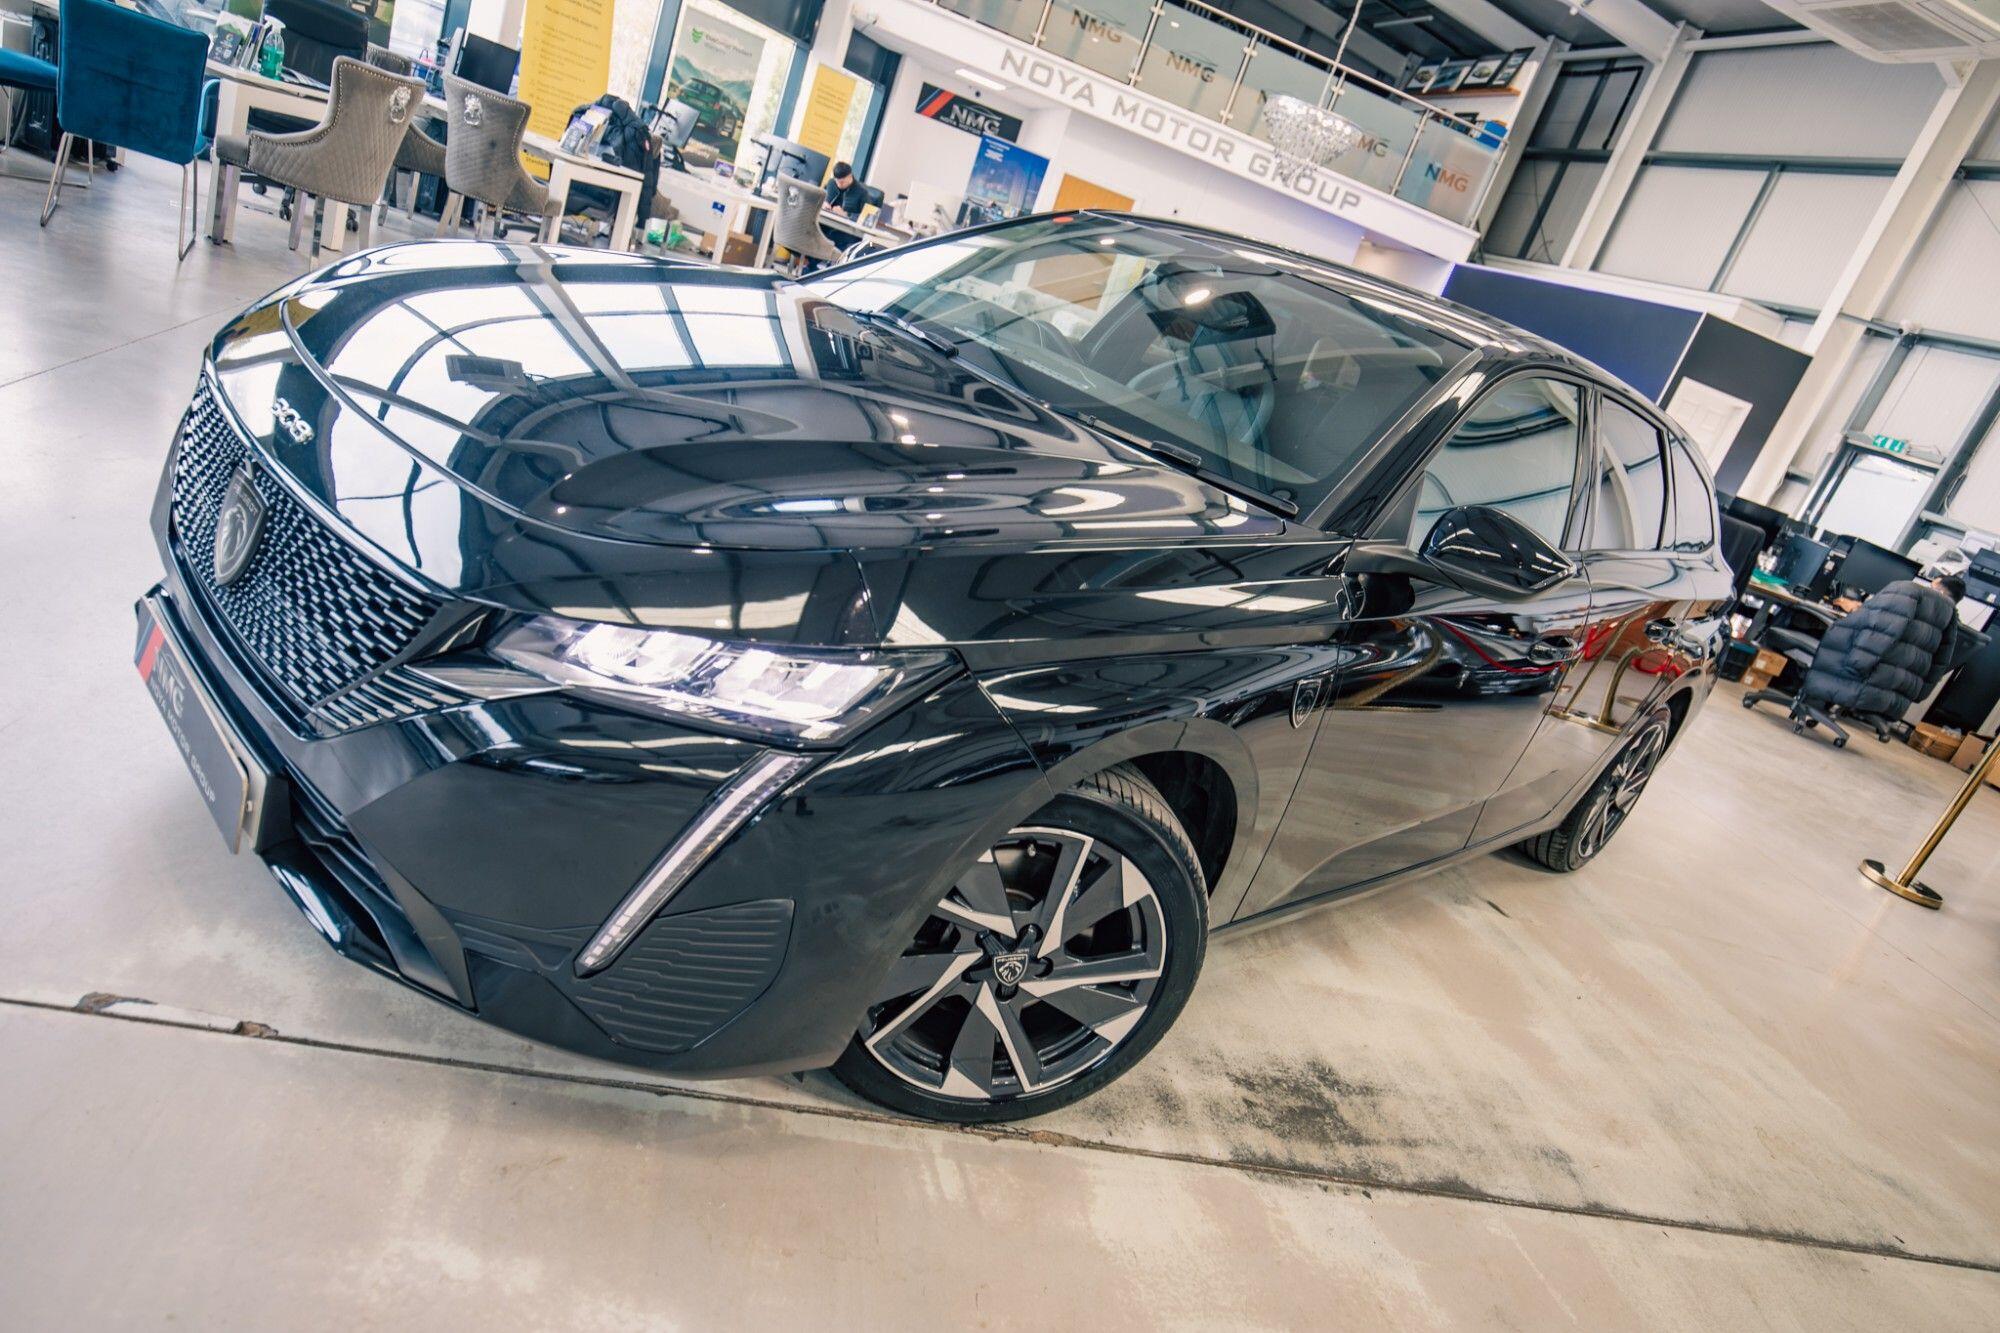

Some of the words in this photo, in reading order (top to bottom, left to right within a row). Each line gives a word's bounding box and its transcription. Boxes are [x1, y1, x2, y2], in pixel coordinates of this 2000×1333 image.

[1071, 9, 1122, 43] NMG
[1166, 50, 1215, 83] NMG
[950, 103, 1001, 136] NMG
[1001, 48, 1095, 108] NOYA
[1112, 95, 1235, 163] MOTOR
[1425, 163, 1468, 193] NMG
[272, 397, 314, 444] 308
[190, 754, 216, 802] GROUP
